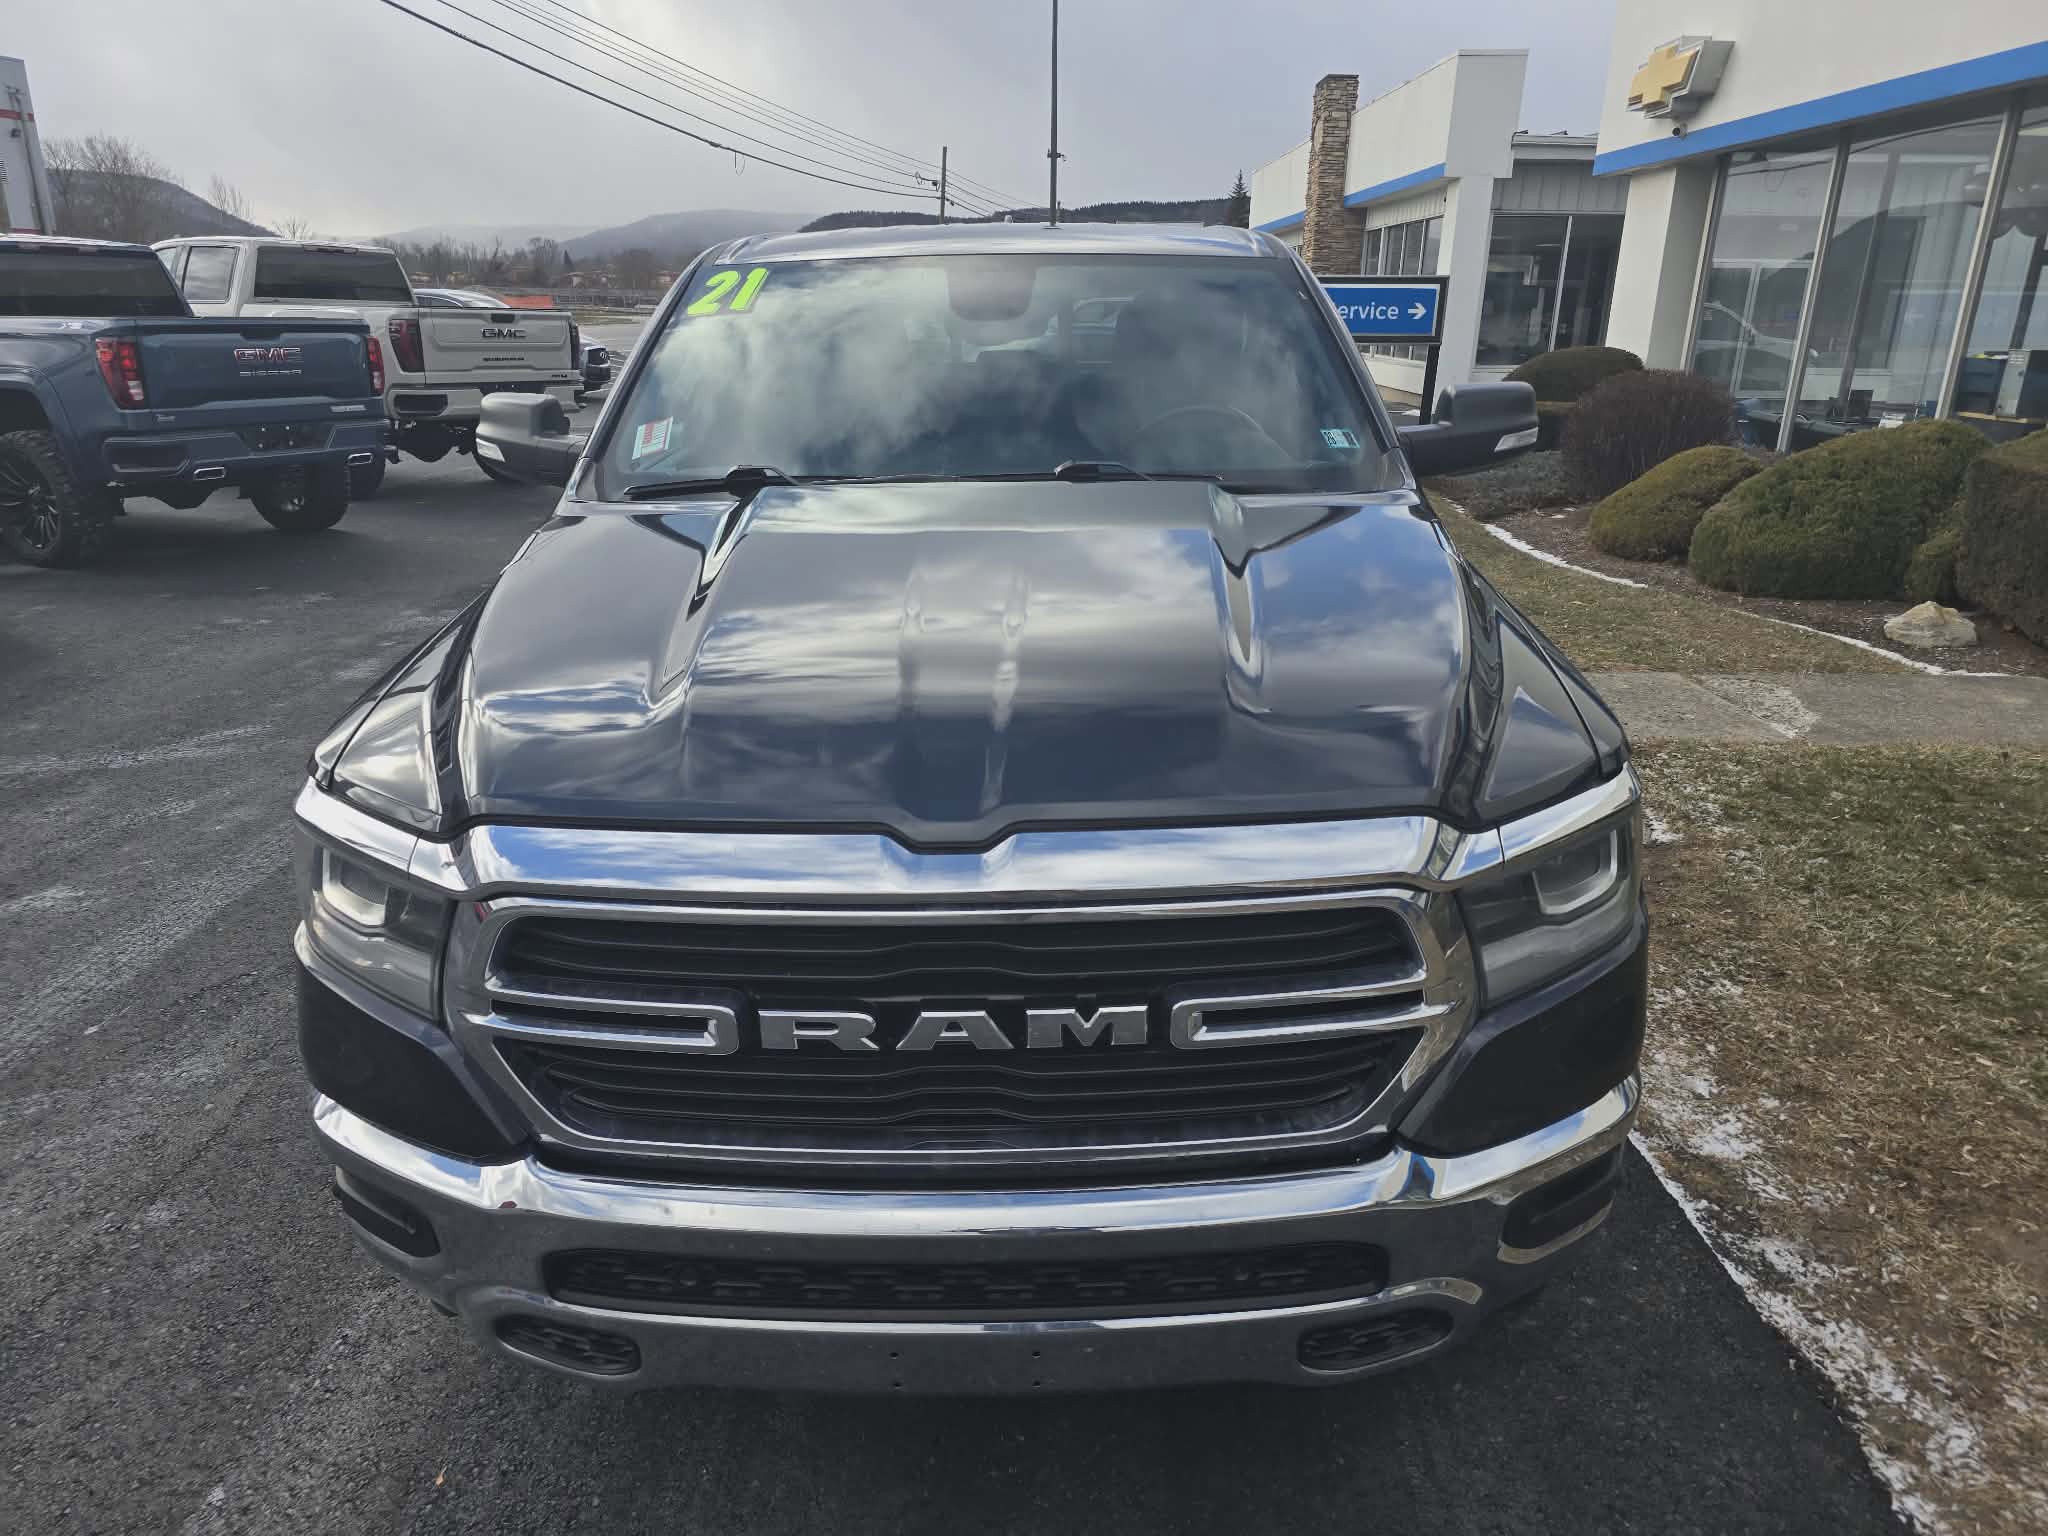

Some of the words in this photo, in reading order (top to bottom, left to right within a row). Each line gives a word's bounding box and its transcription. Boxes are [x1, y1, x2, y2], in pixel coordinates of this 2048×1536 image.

[687, 266, 769, 316] 21
[1337, 301, 1399, 320] ervice
[481, 328, 527, 339] GMC
[234, 347, 302, 362] GMC
[758, 1005, 1149, 1051] RAM
